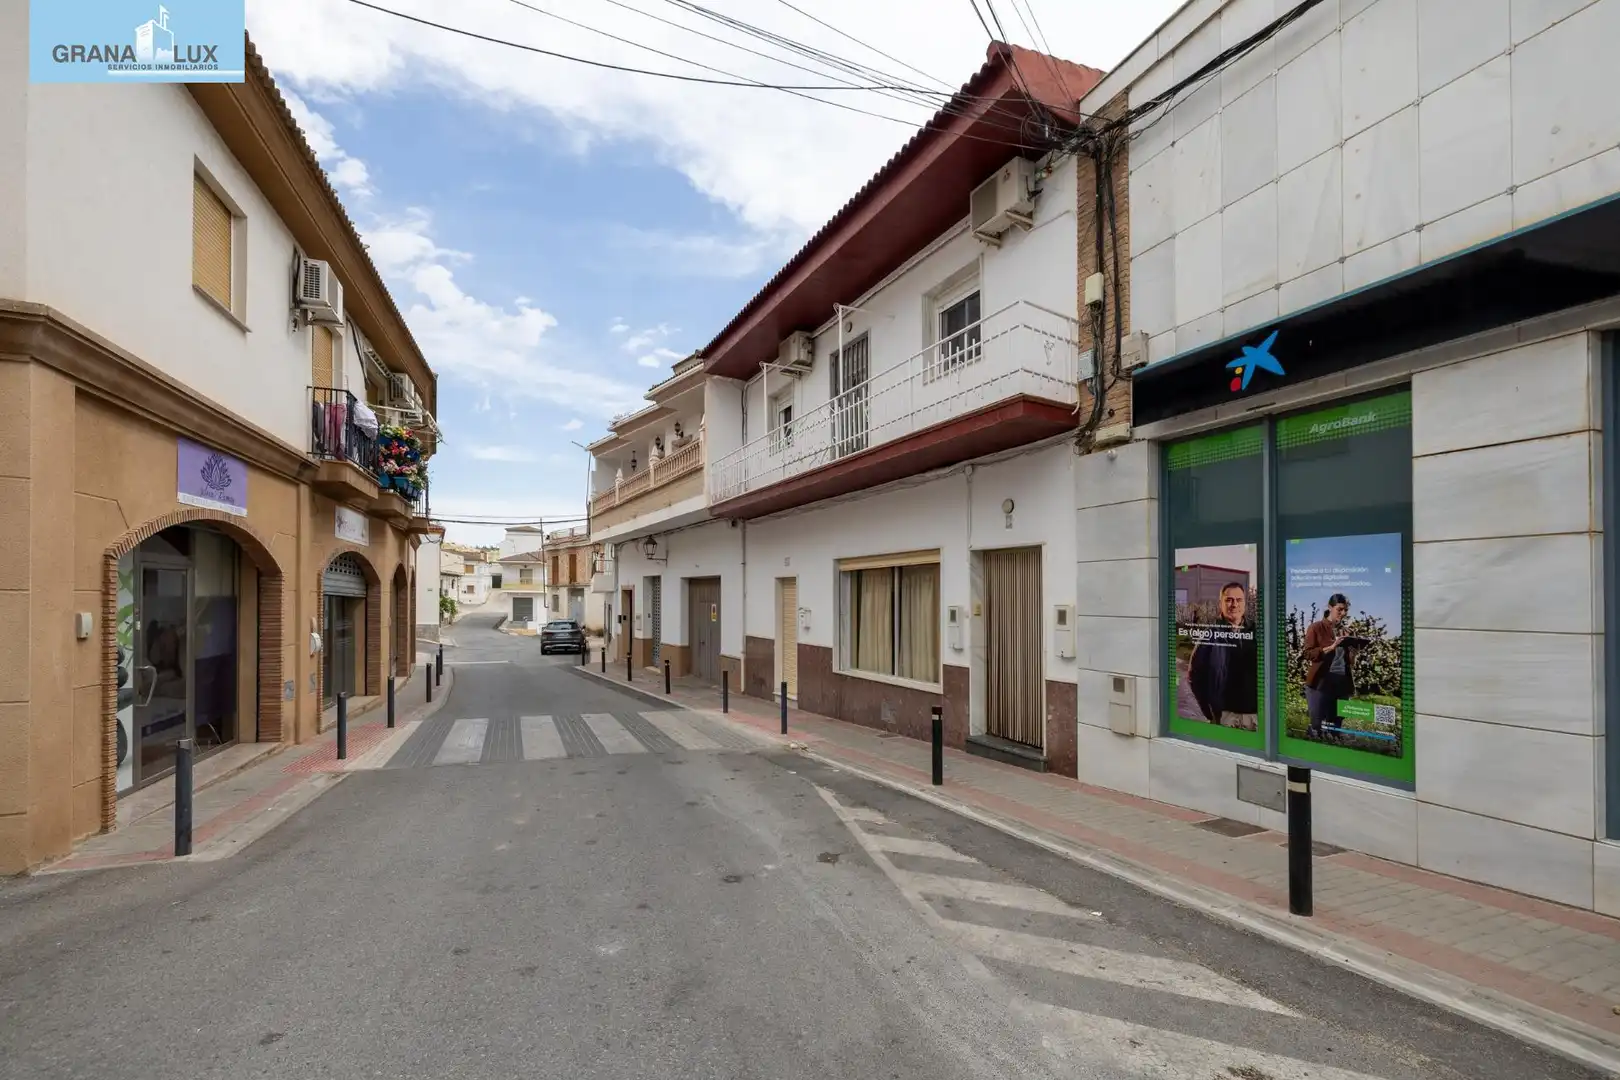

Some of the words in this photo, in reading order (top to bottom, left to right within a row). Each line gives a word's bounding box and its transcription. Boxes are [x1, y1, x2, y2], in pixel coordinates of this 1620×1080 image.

[1308, 412, 1377, 434] AgroBank
[1178, 627, 1188, 636] Es
[1189, 628, 1213, 639] (algo)
[1213, 630, 1254, 641] personal
